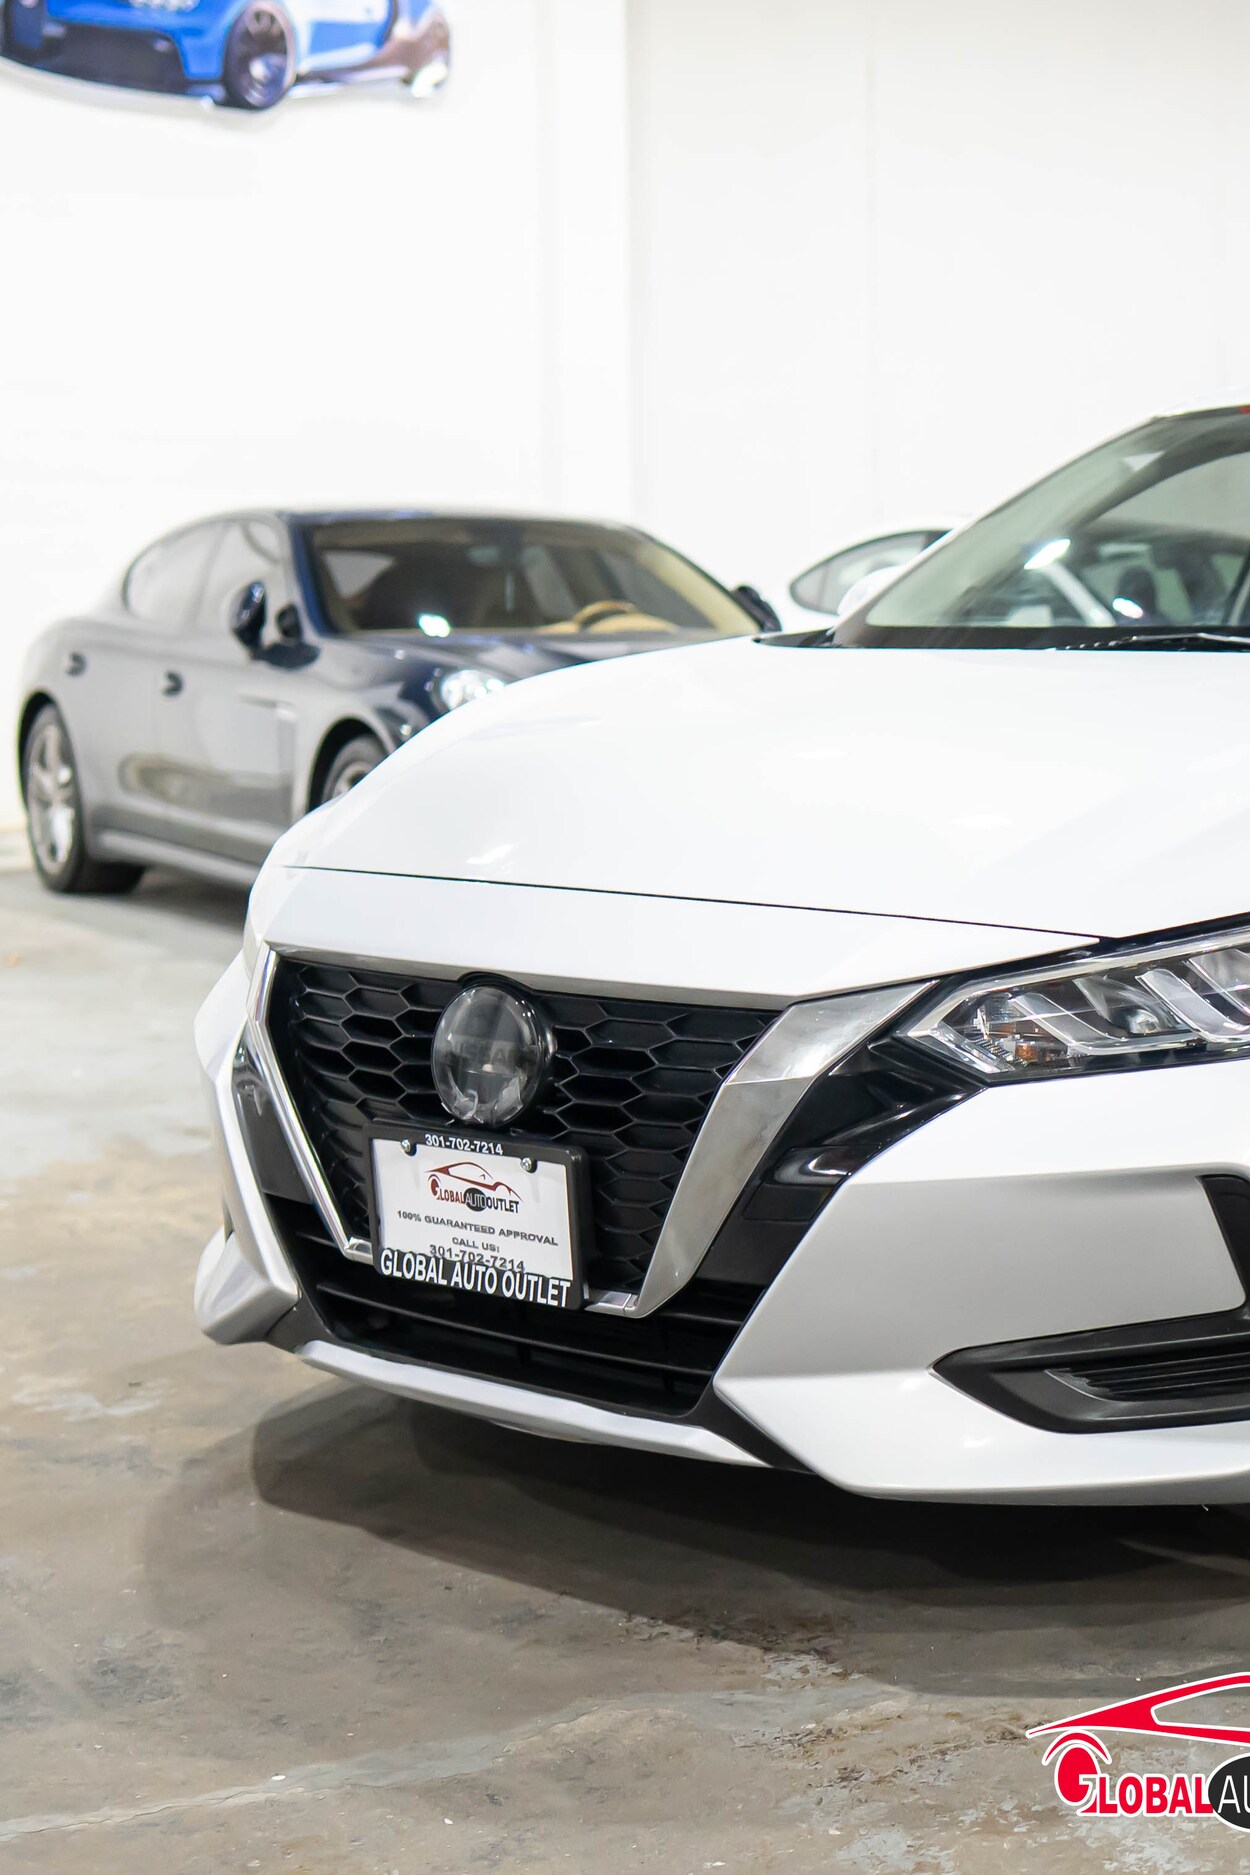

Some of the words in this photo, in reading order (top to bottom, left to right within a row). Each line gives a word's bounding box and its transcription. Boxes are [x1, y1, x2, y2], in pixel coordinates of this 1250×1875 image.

[424, 1133, 504, 1155] 301-702-7214
[430, 1178, 465, 1204] GLOBAL
[465, 1193, 486, 1208] AUTO
[486, 1197, 520, 1214] OUTLET
[397, 1210, 421, 1222] 100%
[424, 1215, 495, 1235] GUARANTEED
[498, 1228, 559, 1246] APPROVAL
[429, 1244, 525, 1272] 301-702-7214
[451, 1237, 479, 1249] CALL
[481, 1241, 500, 1253] US:
[380, 1249, 447, 1286] GLOBAL
[450, 1261, 498, 1295] AUTO
[502, 1270, 571, 1308] OUTLET
